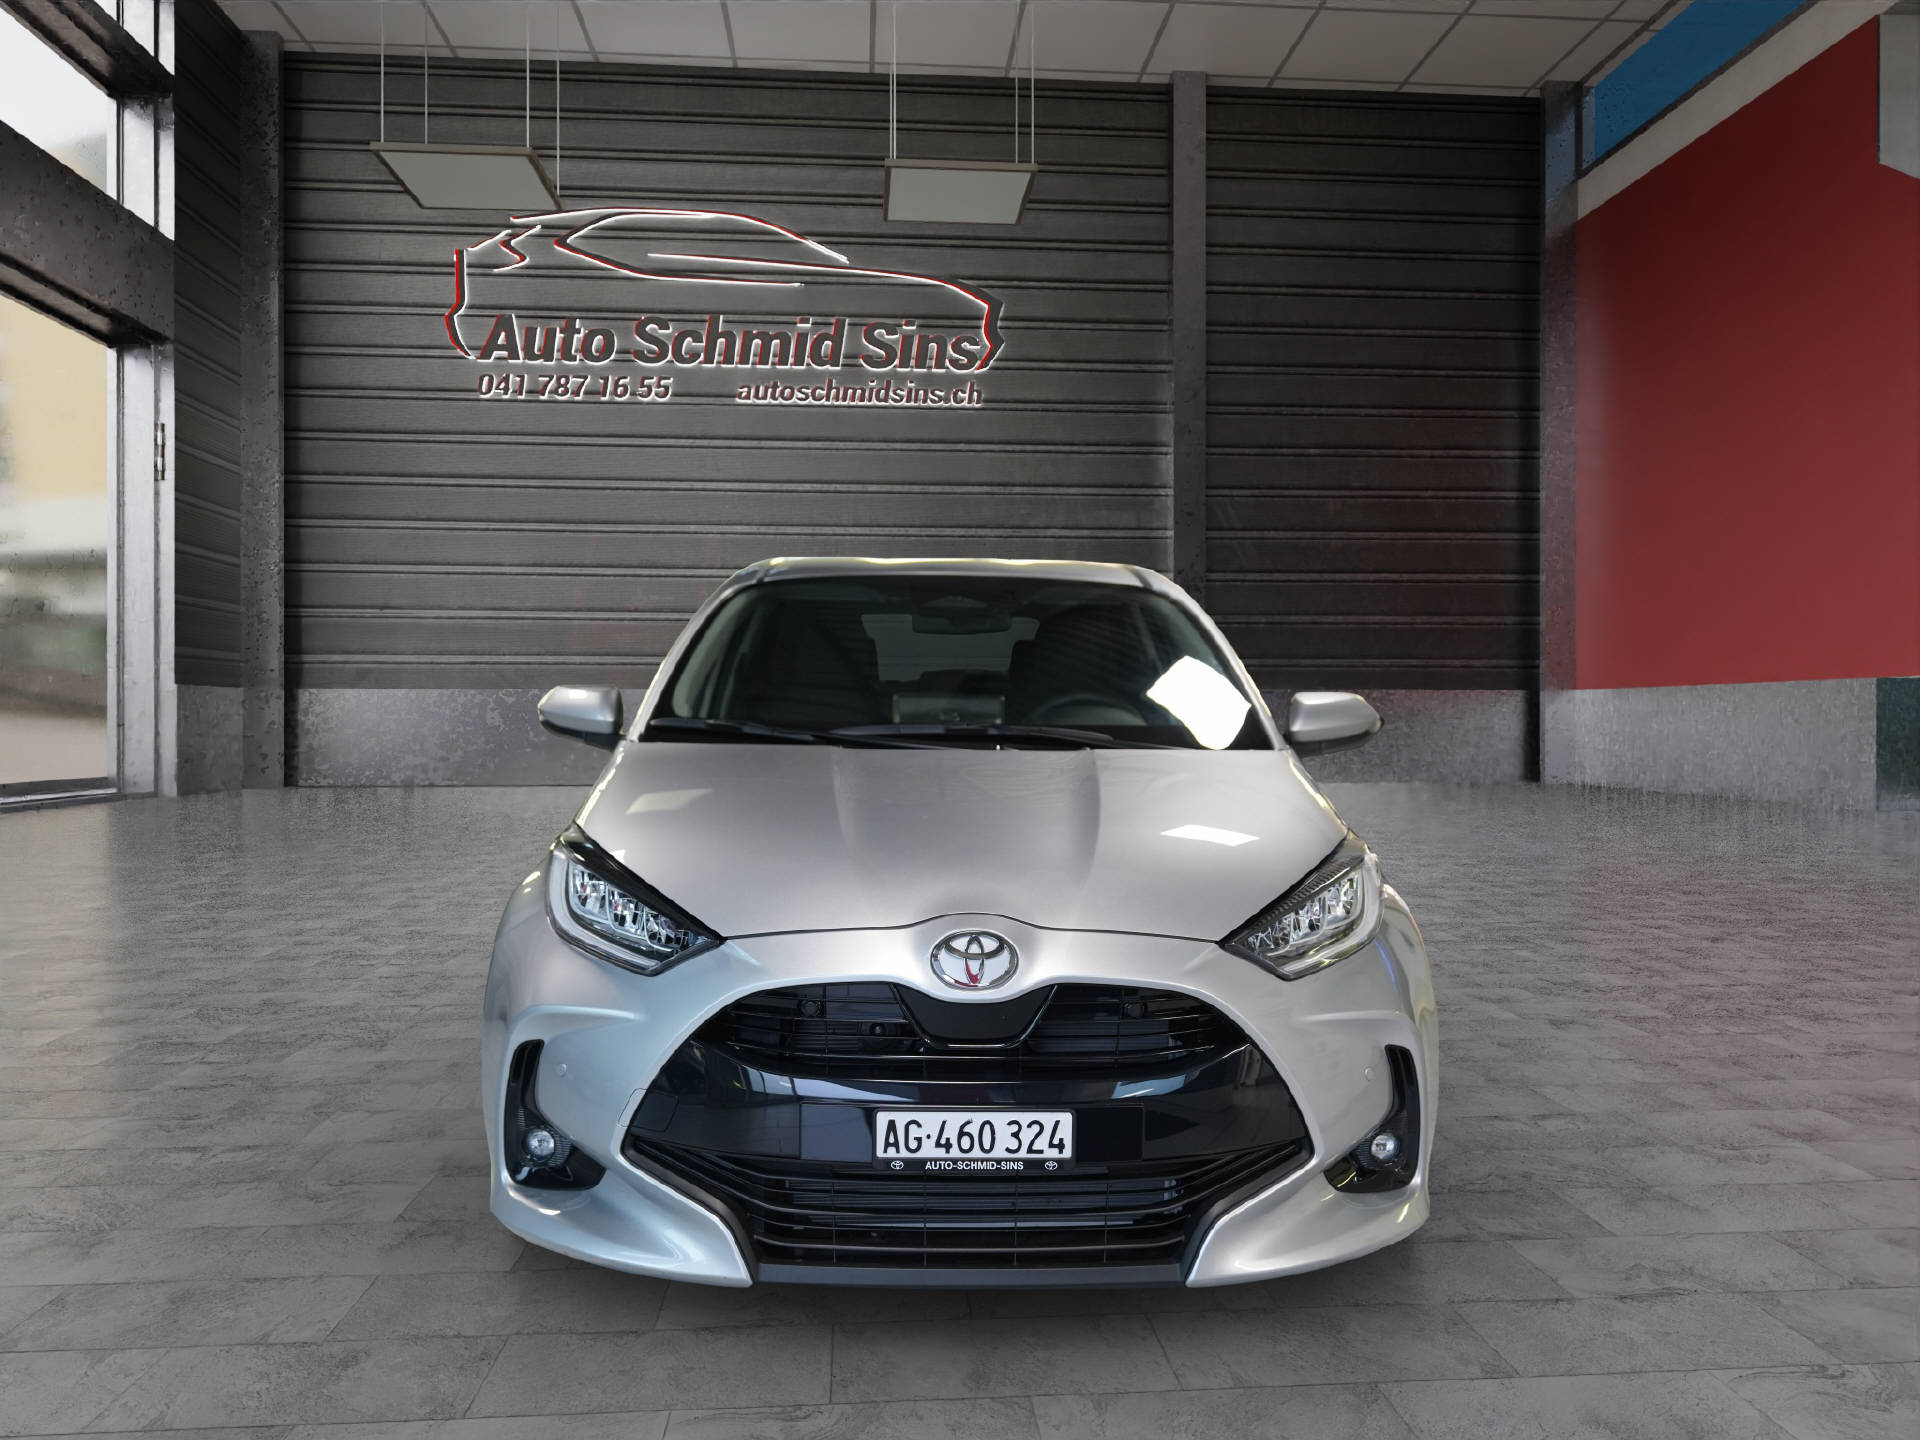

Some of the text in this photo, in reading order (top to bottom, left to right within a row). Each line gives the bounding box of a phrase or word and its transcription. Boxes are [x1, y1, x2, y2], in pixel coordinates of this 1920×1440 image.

[477, 313, 982, 374] Auto Schmid Sins
[478, 373, 673, 401] 041 787 16 55
[735, 377, 983, 406] autoschmidsins.ch
[924, 1160, 1024, 1171] AUTO-SCHMID-SINS
